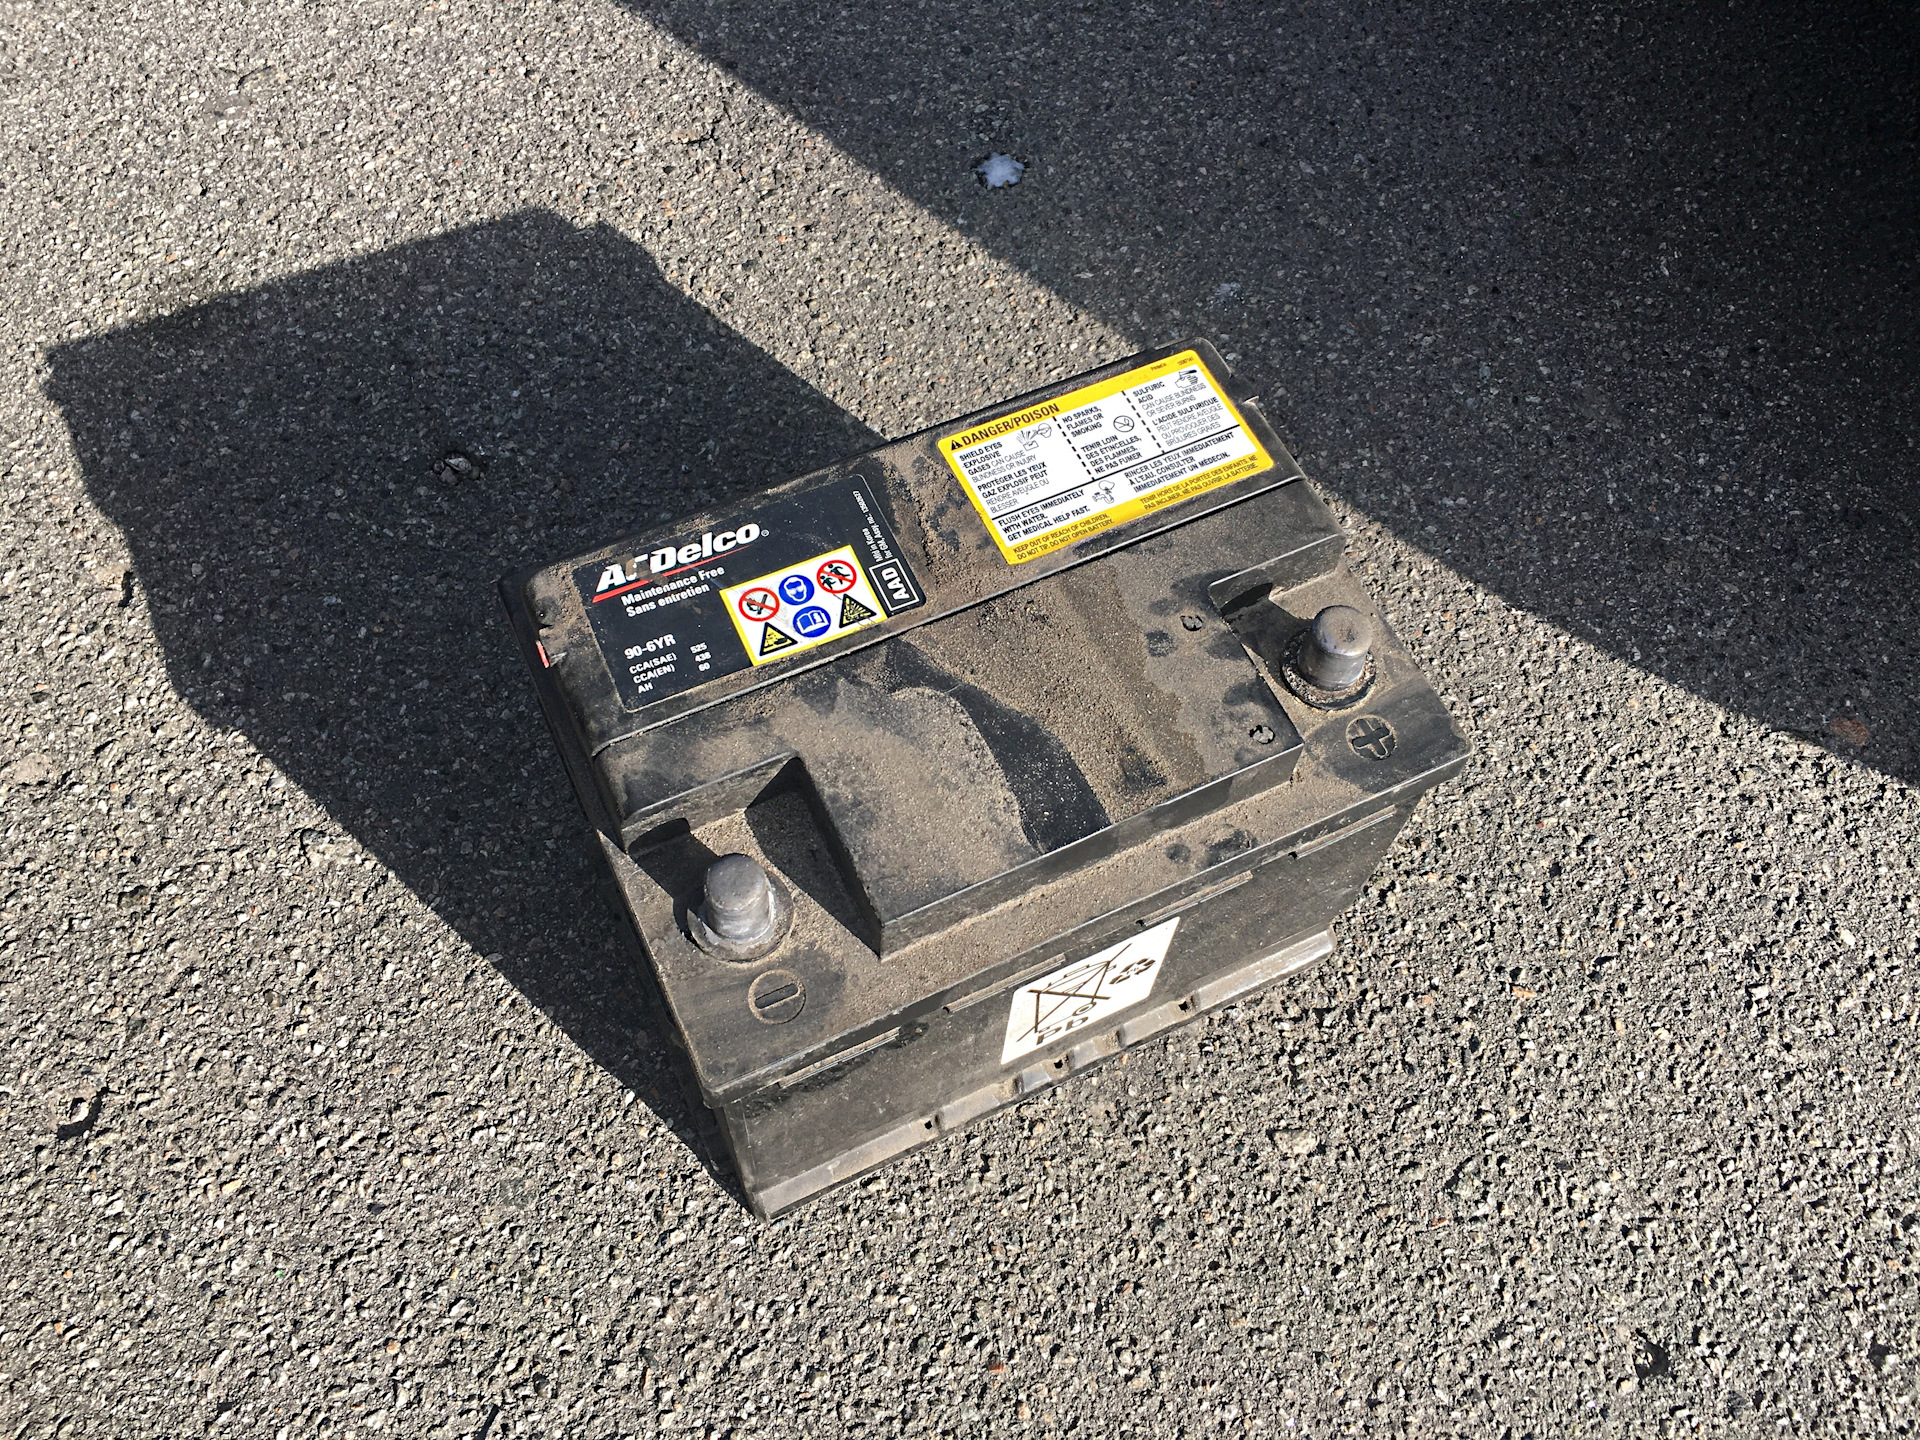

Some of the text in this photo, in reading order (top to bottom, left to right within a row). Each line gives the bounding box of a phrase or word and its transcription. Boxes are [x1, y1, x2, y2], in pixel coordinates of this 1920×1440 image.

[1133, 381, 1165, 397] SULFURIC
[1138, 394, 1154, 404] ACID
[1142, 382, 1206, 410] CAN CAUSE BLINDNESS
[1146, 394, 1196, 417] OR SEVER BURNS
[1156, 403, 1223, 433] PEUT RENDRE AVEUGLE
[1177, 397, 1219, 416] SULFURIQUE
[961, 403, 1060, 446] DANGER/POISON
[1062, 415, 1073, 423] NO
[1066, 413, 1104, 431] FLAMES OR
[1071, 422, 1102, 437] SMOKING
[1161, 413, 1221, 440] OU PROVOQUER DES
[1197, 421, 1221, 434] GRAVES
[959, 442, 1003, 461] SHIELD EYES
[1080, 435, 1118, 452] TENIR LOIN
[1085, 450, 1100, 460] DES
[963, 450, 1001, 469] EXPLOSIVE
[968, 450, 1026, 476] GASES CAN CAUSE
[971, 454, 1036, 483] BLINDNESS OR INJURY
[1013, 469, 1027, 478] LES
[1027, 461, 1047, 473] YEUX
[1090, 457, 1104, 467] DES
[1105, 461, 1119, 470] PAS
[1118, 451, 1142, 465] FUMER
[1124, 465, 1150, 478] RINCER
[1149, 459, 1163, 469] LES
[1163, 452, 1182, 463] YEUX
[1156, 456, 1196, 475] CONSULTER
[1187, 463, 1199, 471] UN
[982, 469, 1048, 499] GAZ EXPLOSIF PEUT
[985, 478, 1050, 506] RENDRE AVEUGLE OU
[1140, 494, 1157, 504] TENIR
[1156, 488, 1173, 498] HORS
[1172, 484, 1182, 492] DE
[1211, 468, 1223, 477] DES
[1144, 502, 1156, 510] PAS
[1190, 484, 1203, 492] PAS
[1202, 476, 1224, 488] OUVRIR
[990, 498, 1019, 514] BLESSER
[998, 489, 1084, 527] FLUSH EYES IMMEDIATELY
[1002, 522, 1021, 534] WITH
[1007, 505, 1090, 541] GET MEDICAL HELP FAST.
[862, 528, 874, 545] Korea
[1013, 543, 1029, 553] KEEP
[1029, 538, 1042, 547] OUT
[1050, 528, 1071, 539] REACH
[1016, 552, 1027, 560] DO
[1026, 547, 1039, 556] NOT
[1059, 534, 1071, 543] NOT
[1071, 529, 1088, 538] OPEN
[621, 567, 725, 606] Maintenance Free
[881, 567, 910, 600] AAD
[626, 584, 710, 617] Sans entretien
[624, 634, 676, 659] 90-6YR
[629, 642, 707, 674] CCA(SAE) 525
[633, 652, 711, 684] CCA(EN) 438
[638, 662, 710, 694] AH 60
[1036, 1016, 1089, 1046] Pb
